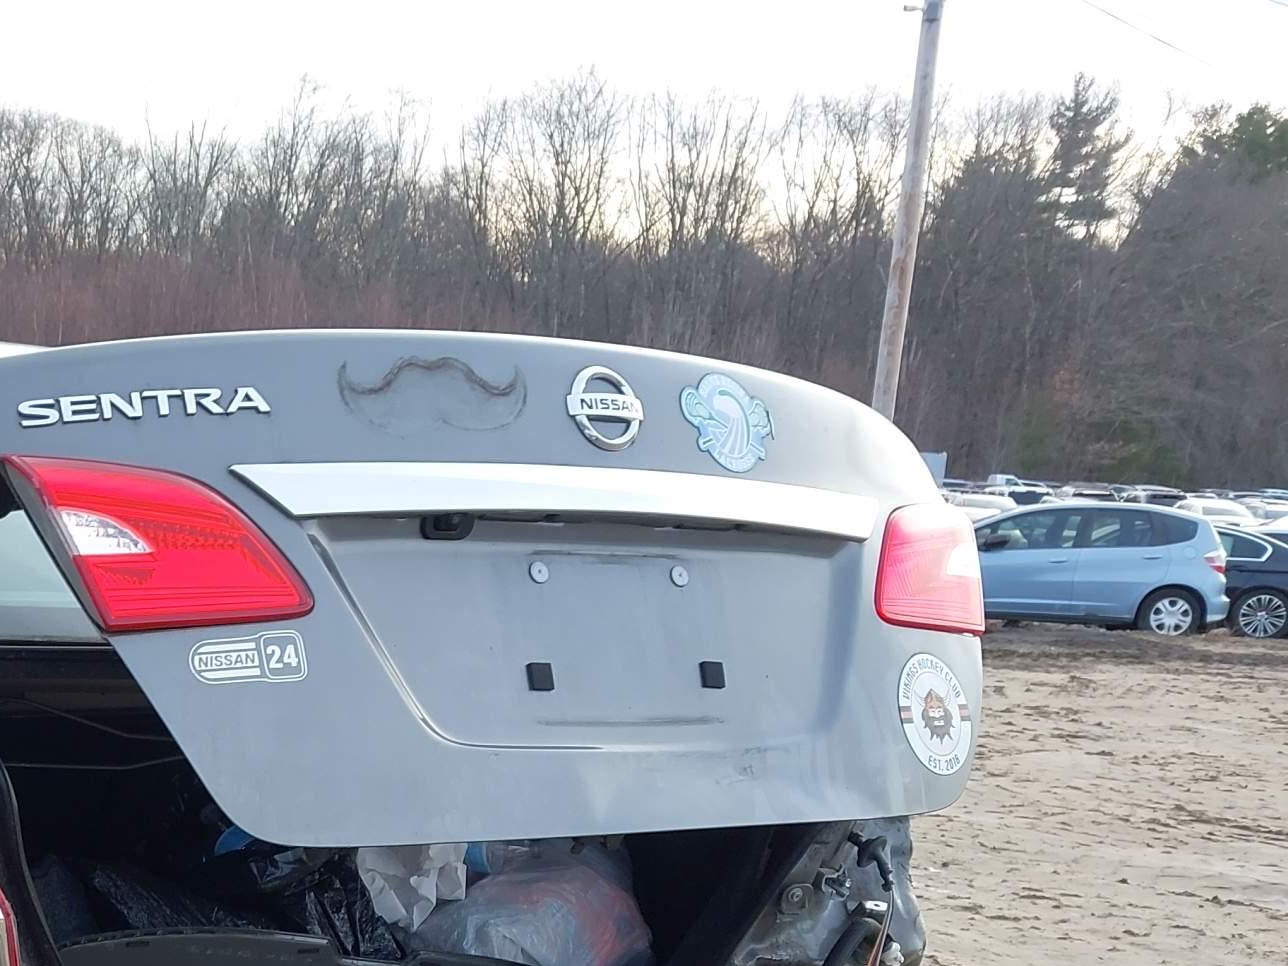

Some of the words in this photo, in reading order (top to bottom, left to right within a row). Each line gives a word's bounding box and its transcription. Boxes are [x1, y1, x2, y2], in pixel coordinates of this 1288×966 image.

[17, 386, 272, 428] SENTRA
[579, 397, 641, 415] NISSAN
[197, 652, 256, 668] NISSAN
[266, 643, 299, 669] 24
